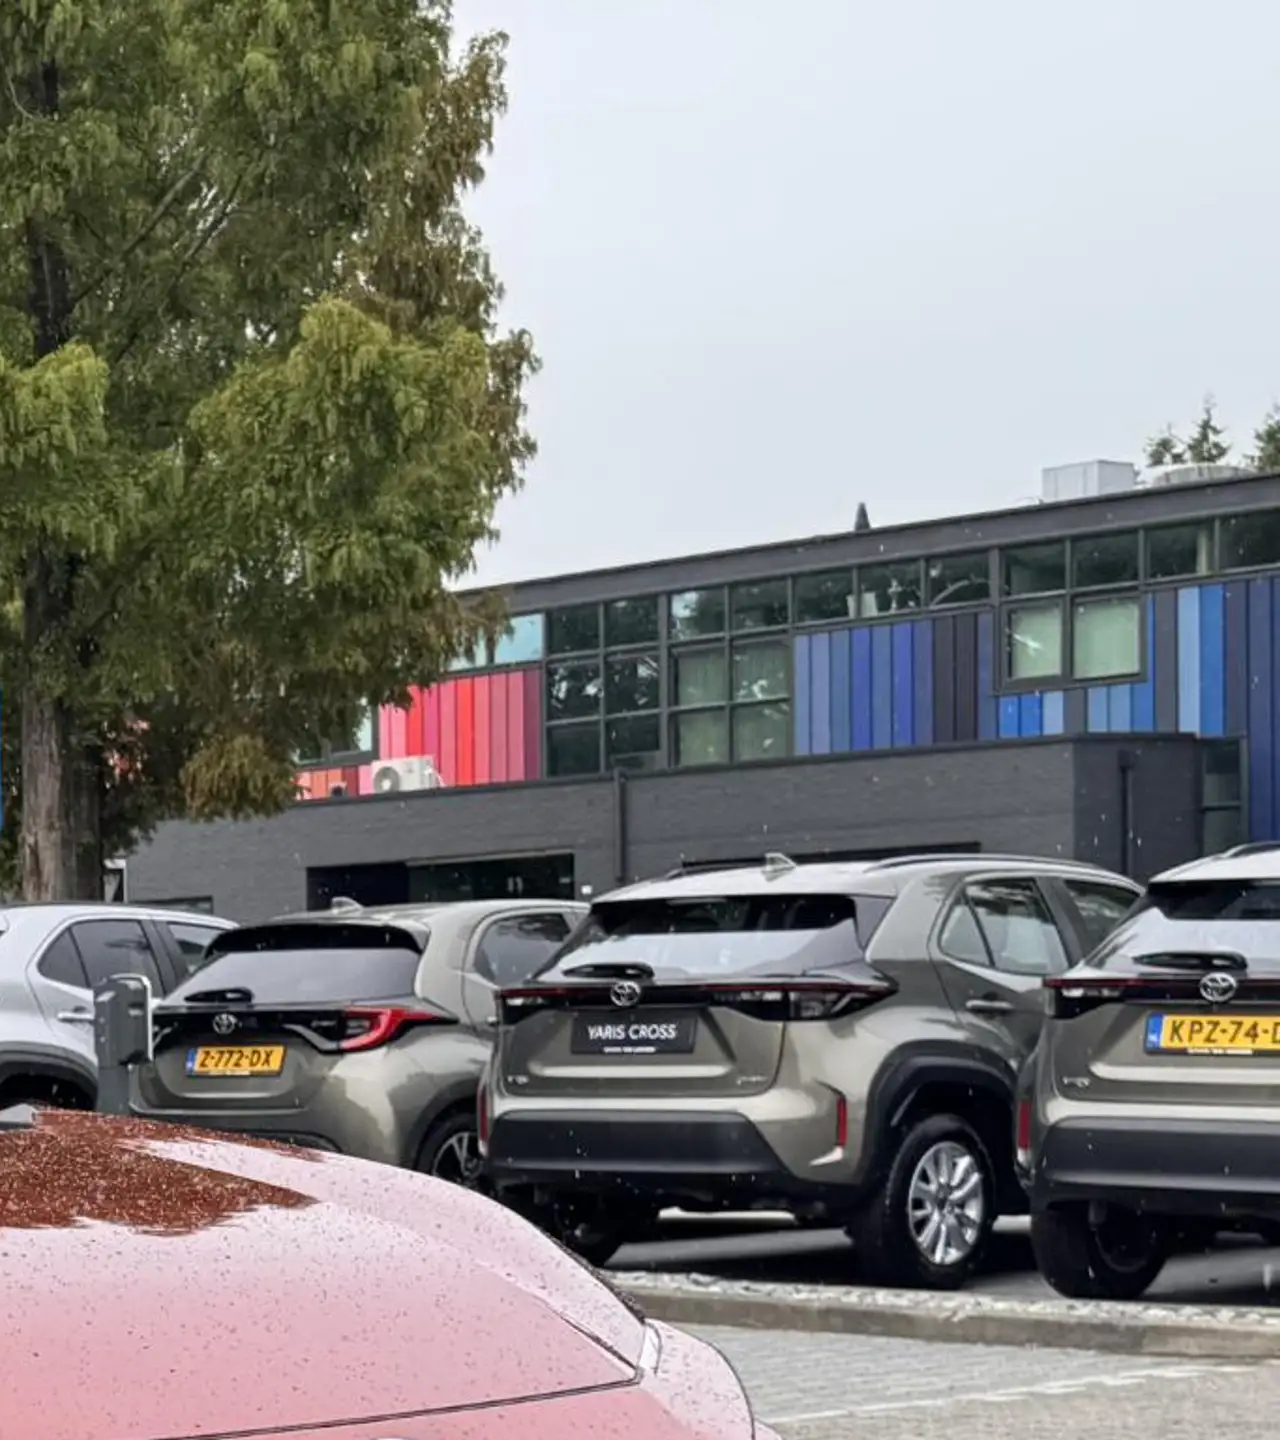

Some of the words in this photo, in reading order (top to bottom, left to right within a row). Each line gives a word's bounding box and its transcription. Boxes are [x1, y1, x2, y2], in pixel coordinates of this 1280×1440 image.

[587, 1023, 626, 1040] YARIS
[627, 1023, 678, 1040] CROSS
[199, 1048, 275, 1069] Z-772-DX
